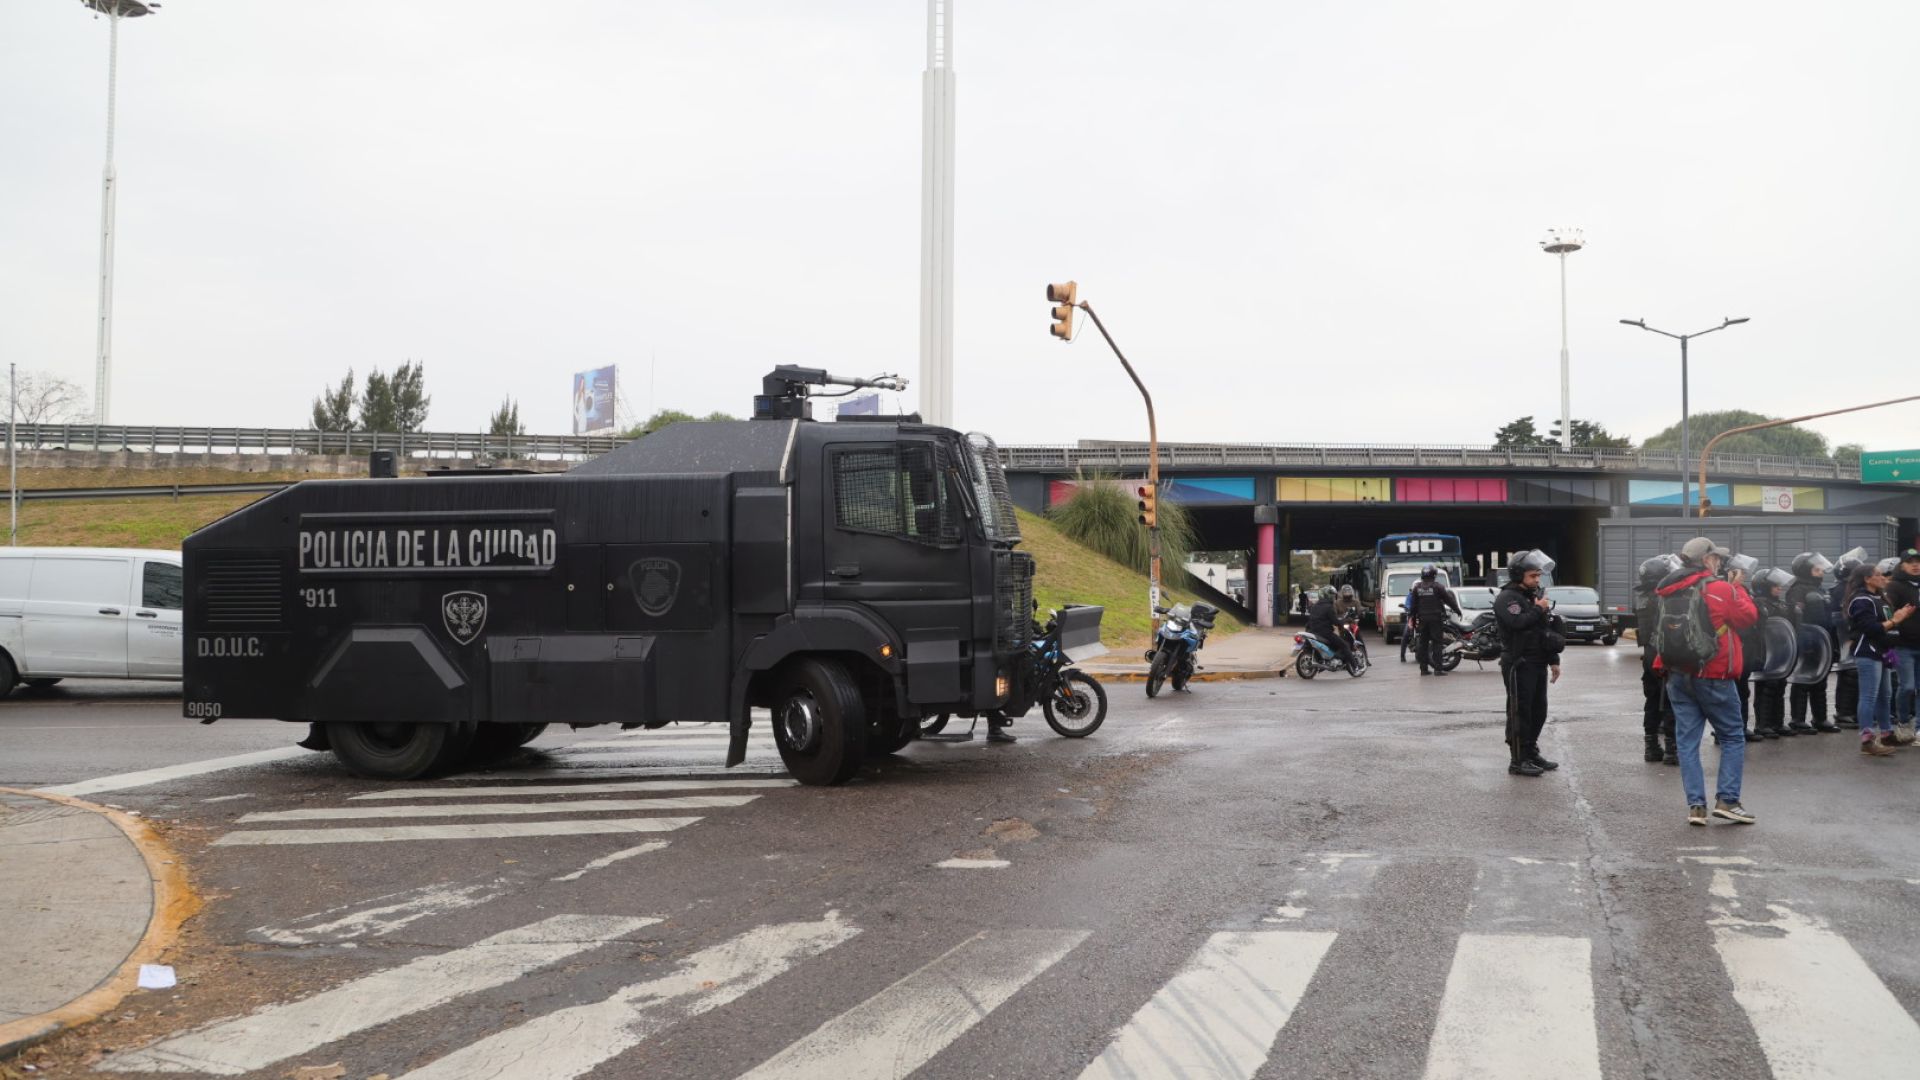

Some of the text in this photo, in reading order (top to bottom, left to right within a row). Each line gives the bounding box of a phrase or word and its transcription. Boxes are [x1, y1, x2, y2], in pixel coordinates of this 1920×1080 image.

[299, 530, 389, 568] POLICIA
[396, 530, 426, 567] DE
[433, 529, 461, 567] LA
[1396, 540, 1443, 553] 110
[197, 637, 264, 657] D.O.U.C.
[188, 702, 222, 717] 9050
